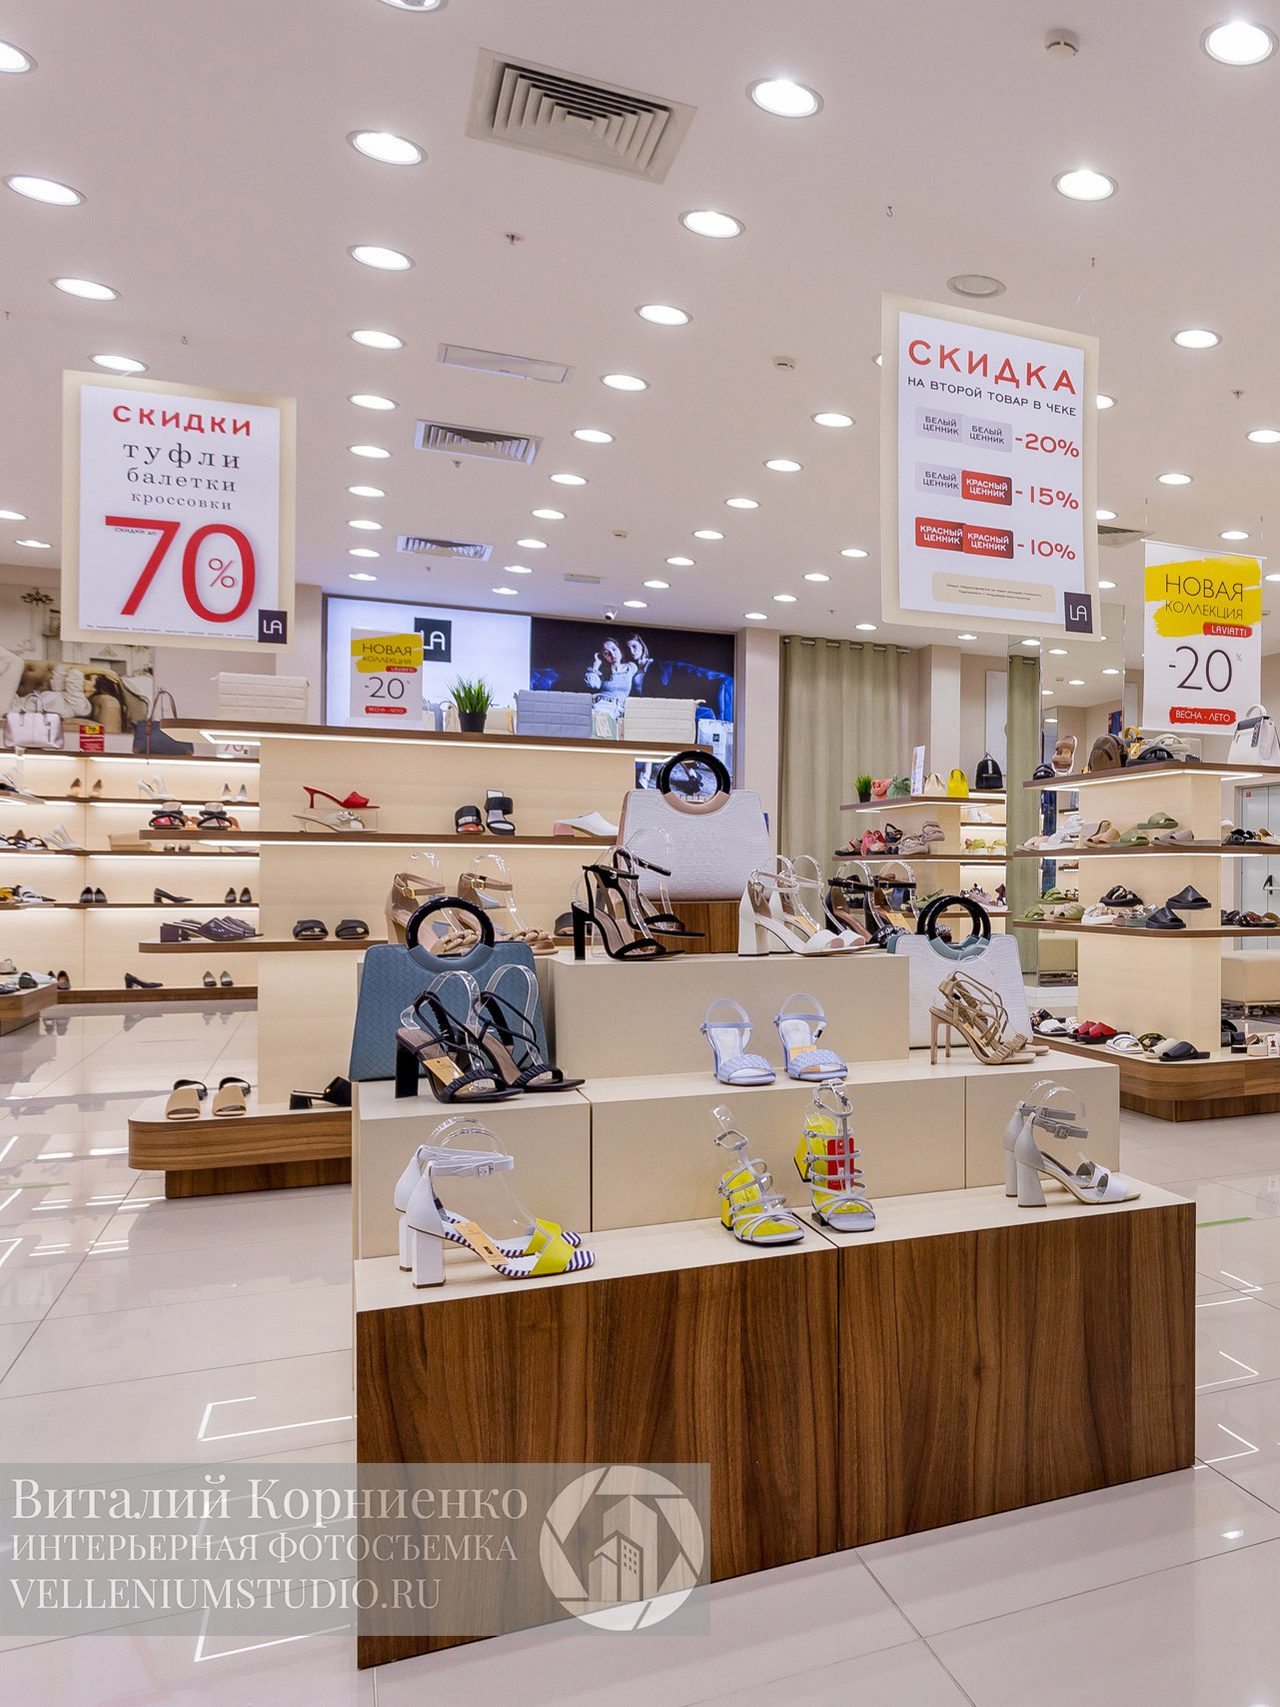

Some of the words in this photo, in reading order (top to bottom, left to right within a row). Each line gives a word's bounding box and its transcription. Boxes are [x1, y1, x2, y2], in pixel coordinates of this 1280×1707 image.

[908, 339, 1077, 395] СКИДКА
[908, 376, 925, 389] НА
[930, 381, 982, 399] ВТОРОЙ
[987, 391, 1028, 407] ТОВАР
[1033, 400, 1042, 411] В
[1046, 402, 1077, 417] ЧЕКЕ
[113, 405, 251, 437] СКИДКИ
[924, 415, 957, 428] БЕЛЫЙ
[922, 422, 959, 436] ЦЕННИК
[971, 424, 1003, 437] БЕЛЫЙ
[969, 431, 1005, 445] ЦЕННИК
[1015, 433, 1080, 458] -20%
[123, 443, 240, 469] туфли
[127, 467, 236, 493] балетки
[924, 470, 957, 483] БЕЛЫЙ
[922, 477, 959, 491] ЦЕННИК
[966, 478, 1008, 492] КРАСНЫЙ
[969, 485, 1005, 499] ЦЕННИК
[131, 492, 232, 511] кроссовки
[920, 524, 963, 538] КРАСНЫЙ
[924, 531, 960, 545] ЦЕННИК
[967, 531, 1009, 546] КРАСНЫЙ
[971, 539, 1007, 553] ЦЕННИК
[1165, 574, 1243, 602] НОВАЯ
[1165, 600, 1243, 620] КОЛЛЕКЦИЯ
[1211, 625, 1247, 637] LAVIATTI
[363, 643, 412, 656] НОВАЯ
[363, 656, 412, 665] КОЛЛЕКЦИЯ
[1175, 710, 1203, 720] ВЕСНА
[1208, 711, 1231, 722] ЛЕТО
